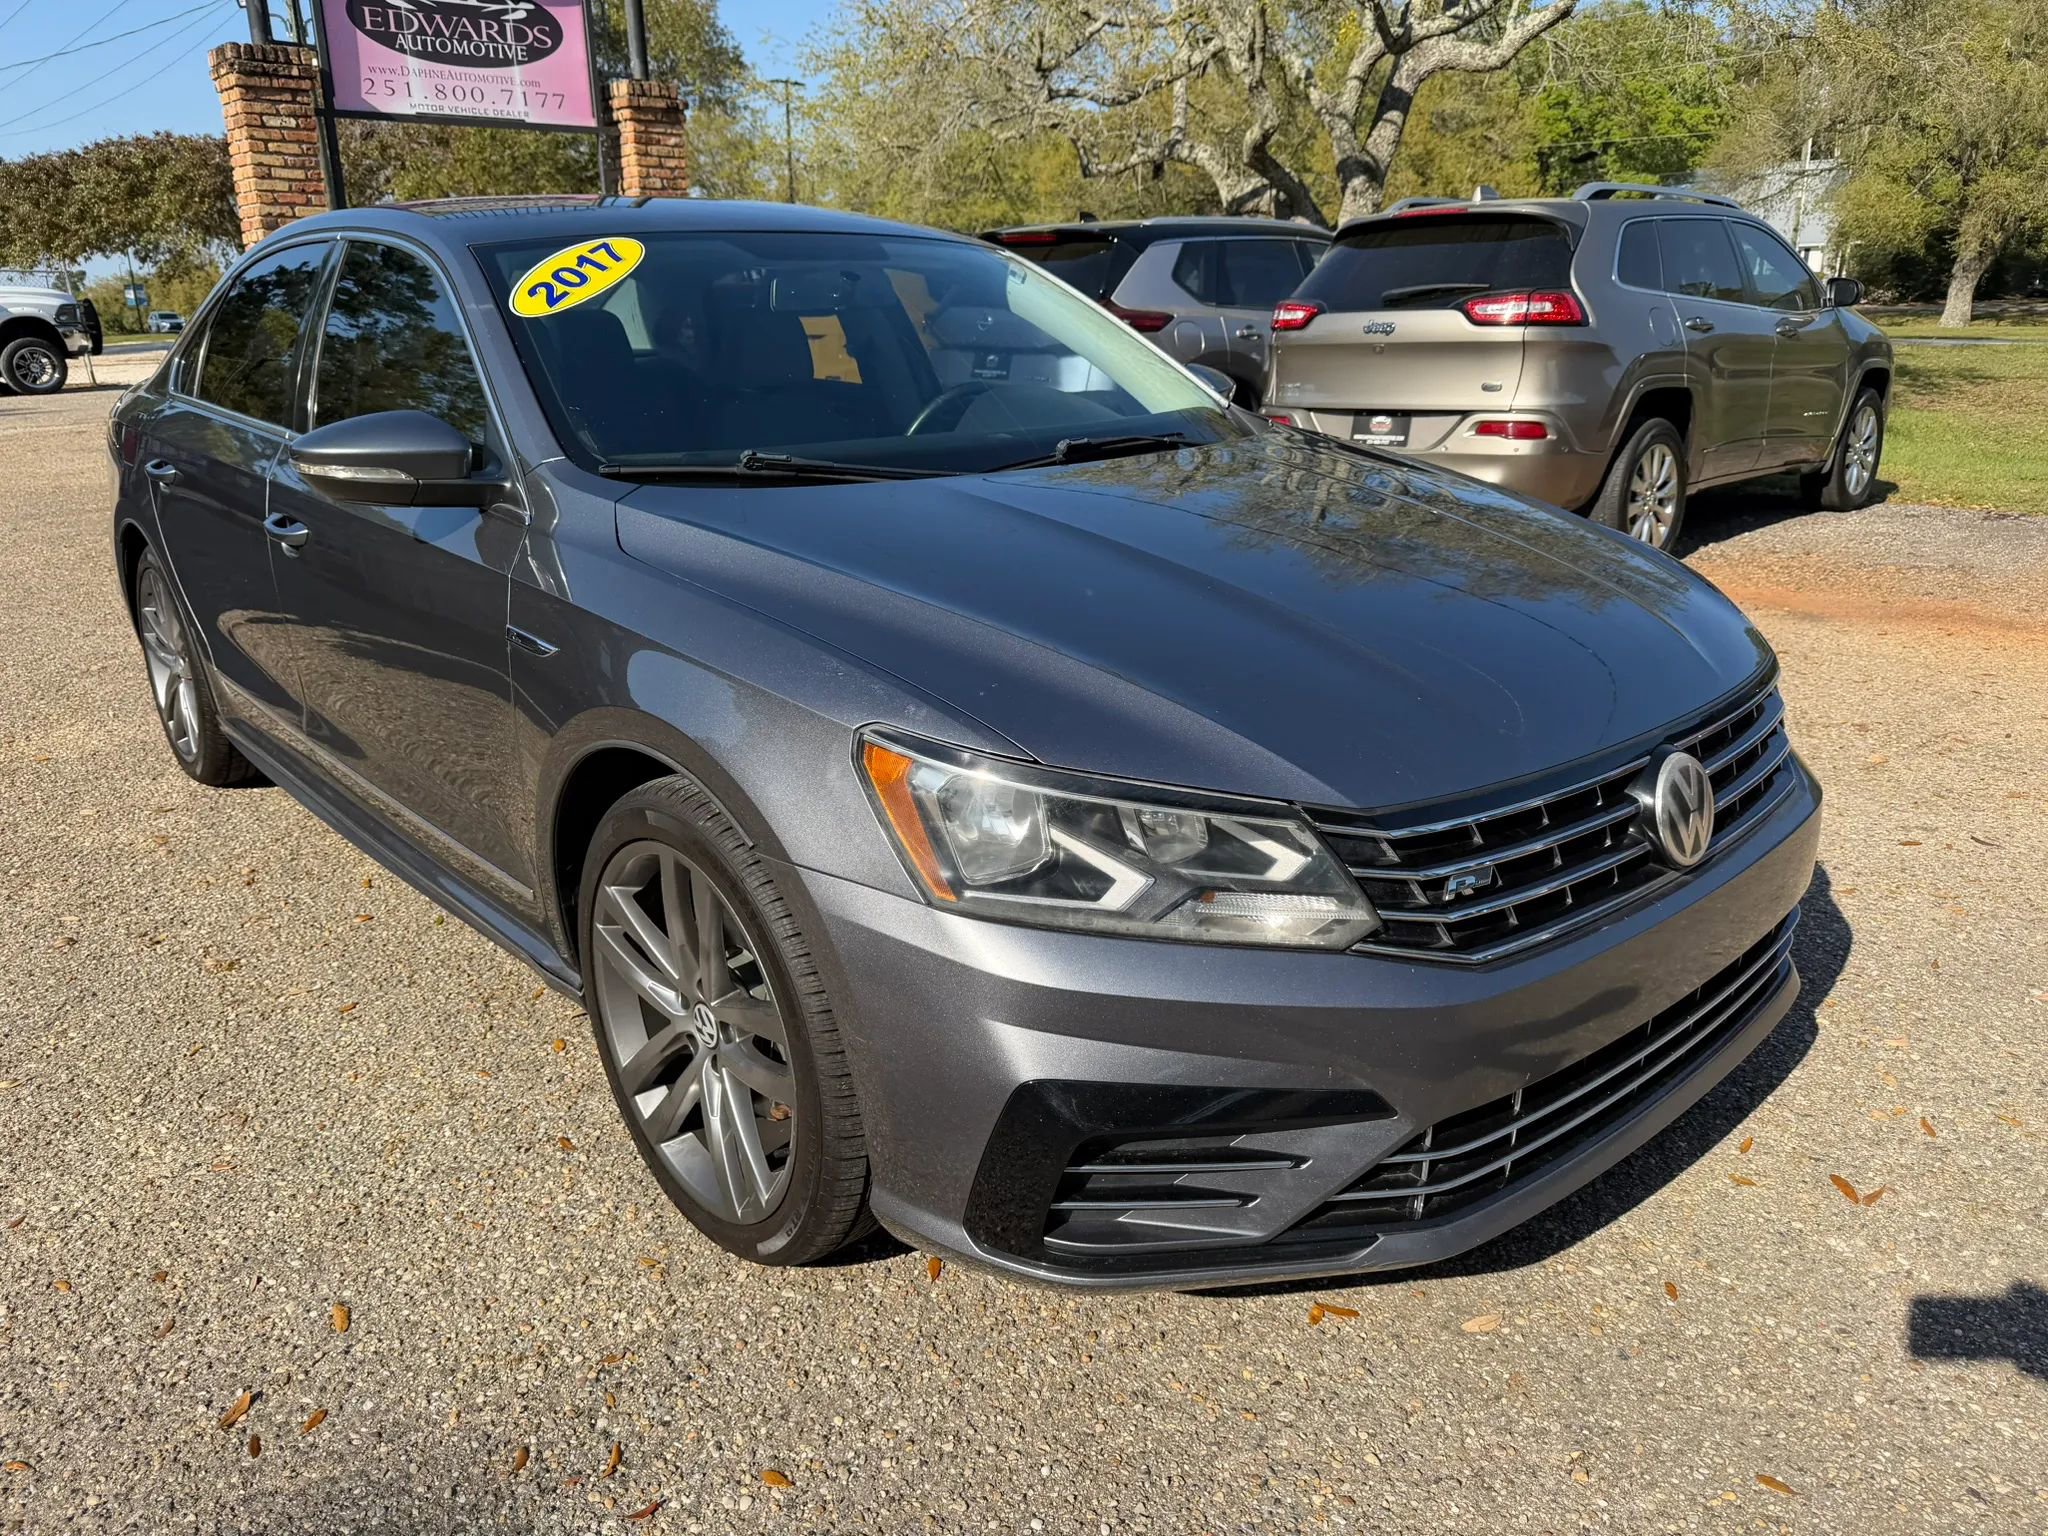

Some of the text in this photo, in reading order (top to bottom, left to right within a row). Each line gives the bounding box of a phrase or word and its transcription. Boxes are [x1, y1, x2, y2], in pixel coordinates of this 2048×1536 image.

[362, 6, 552, 49] EDWARDS
[395, 33, 528, 61] AUTOMOTIVE
[409, 102, 531, 119] MOTOR VEHICLE DEALER
[528, 241, 622, 308] 2017
[1363, 319, 1395, 336] Jeep
